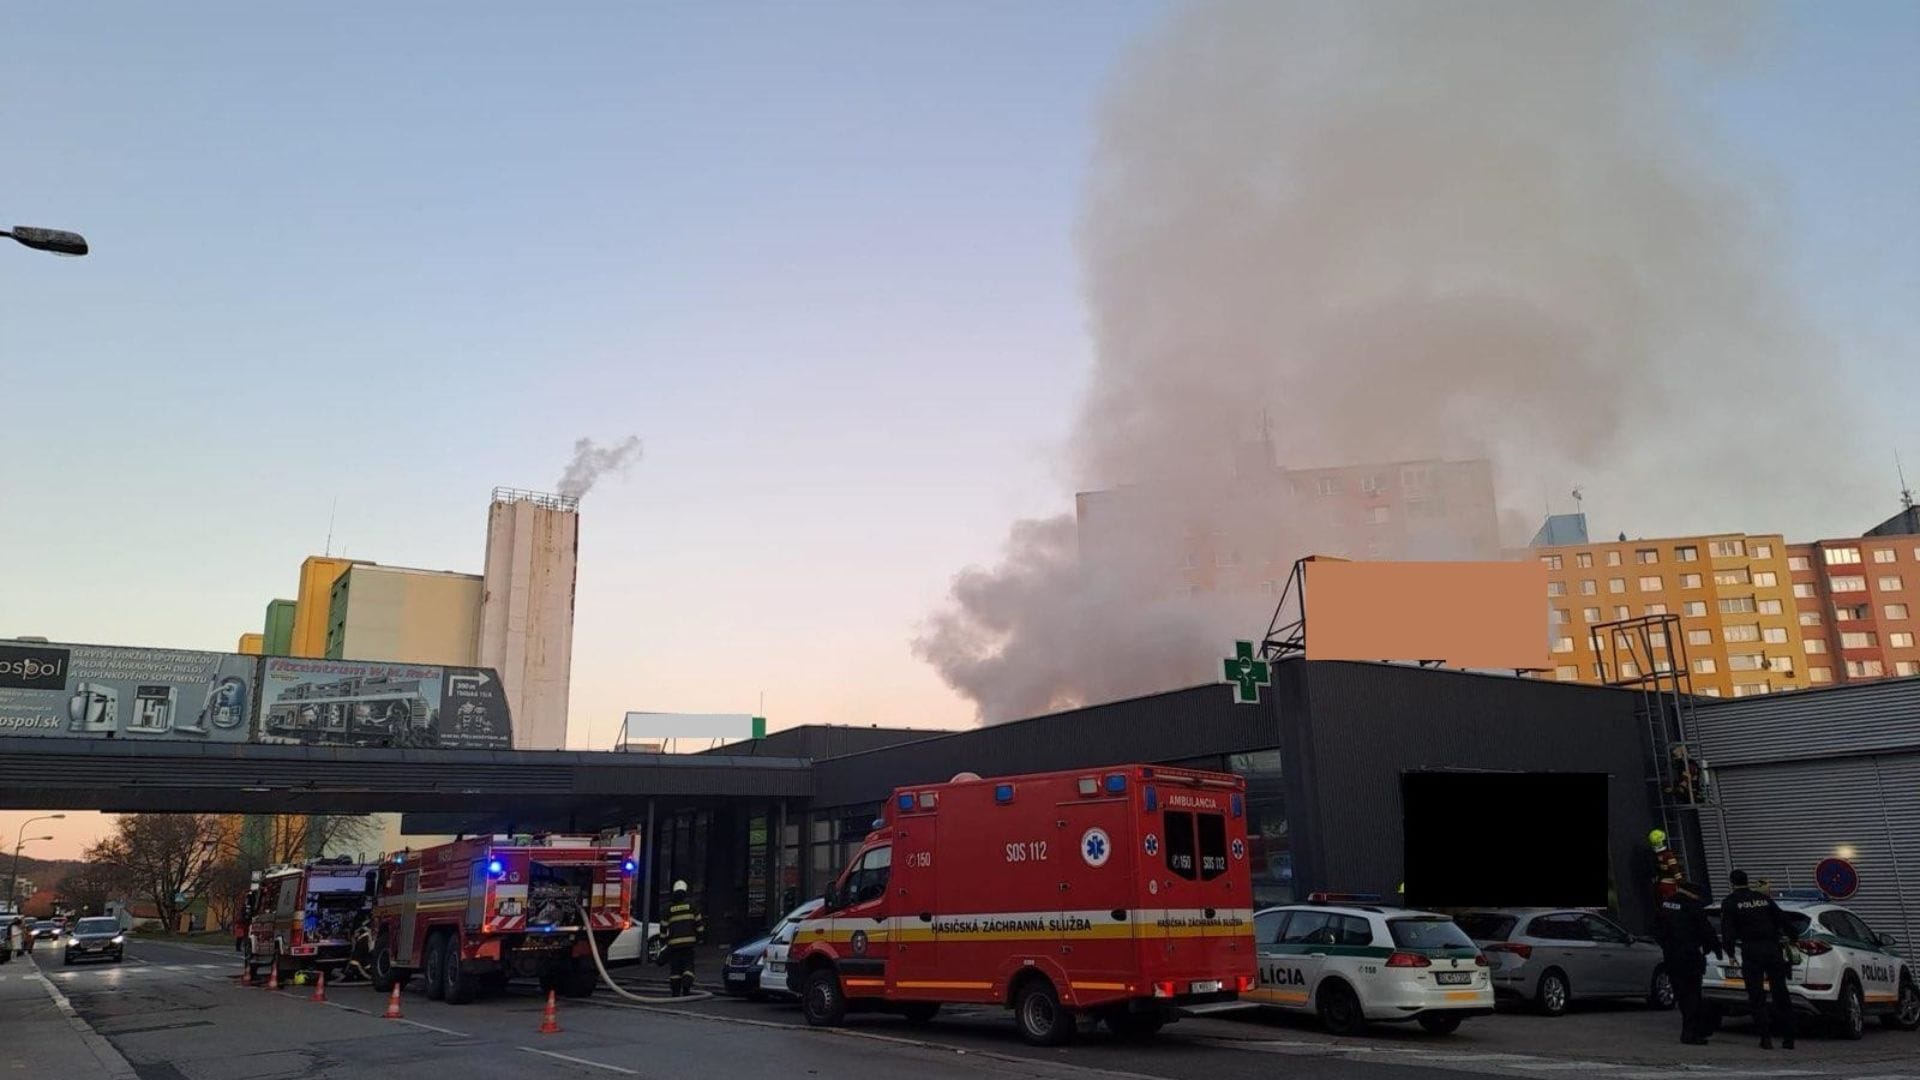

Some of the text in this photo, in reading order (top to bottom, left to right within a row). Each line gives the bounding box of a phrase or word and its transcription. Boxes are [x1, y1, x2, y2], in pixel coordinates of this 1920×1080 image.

[1169, 795, 1217, 808] AMBULANCIA
[1006, 841, 1047, 862] SOS 112
[917, 852, 931, 867] 150
[1180, 855, 1192, 869] 150
[1203, 856, 1225, 870] SOS 112
[931, 915, 1092, 934] HASIČSKÁ ZÁCHRANNÁ SLUŽBA
[1861, 961, 1888, 982] POLÍCIA
